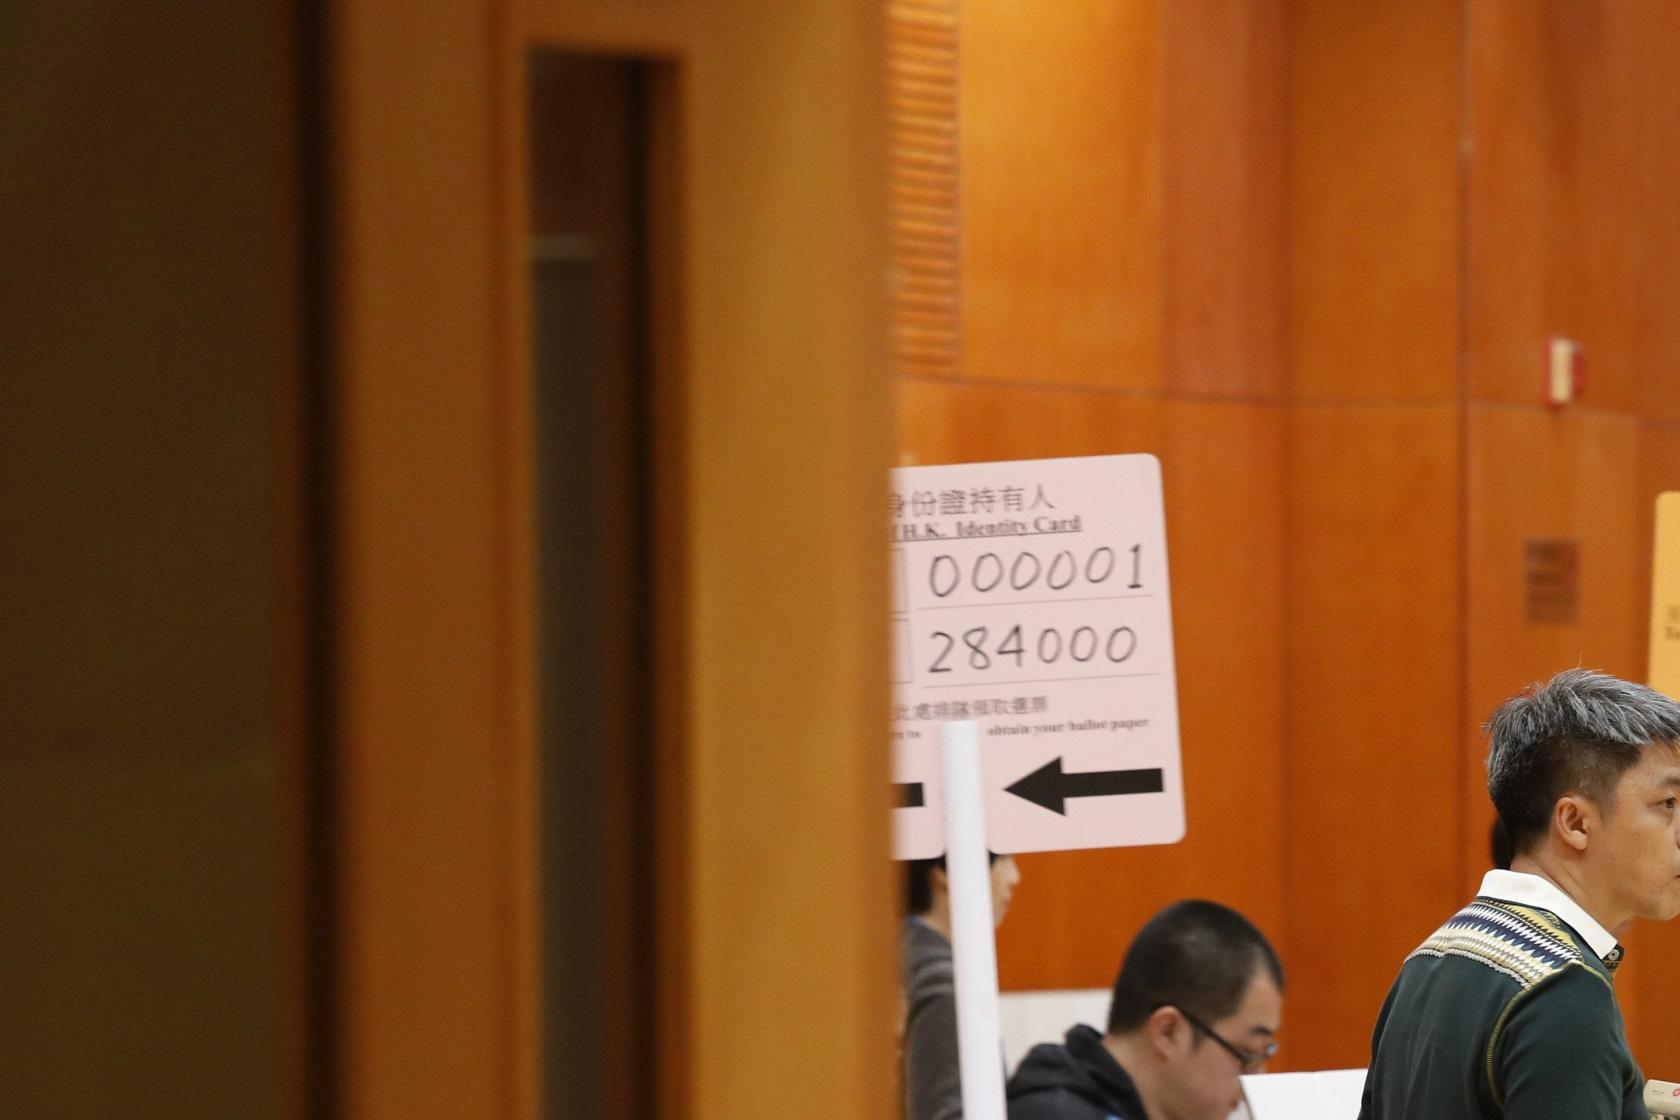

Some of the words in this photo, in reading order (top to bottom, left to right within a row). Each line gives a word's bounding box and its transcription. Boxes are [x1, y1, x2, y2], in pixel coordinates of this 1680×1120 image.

[956, 518, 1027, 537] Identity
[1033, 515, 1082, 533] Card
[929, 543, 1144, 598] 000001
[927, 624, 1137, 673] 284000
